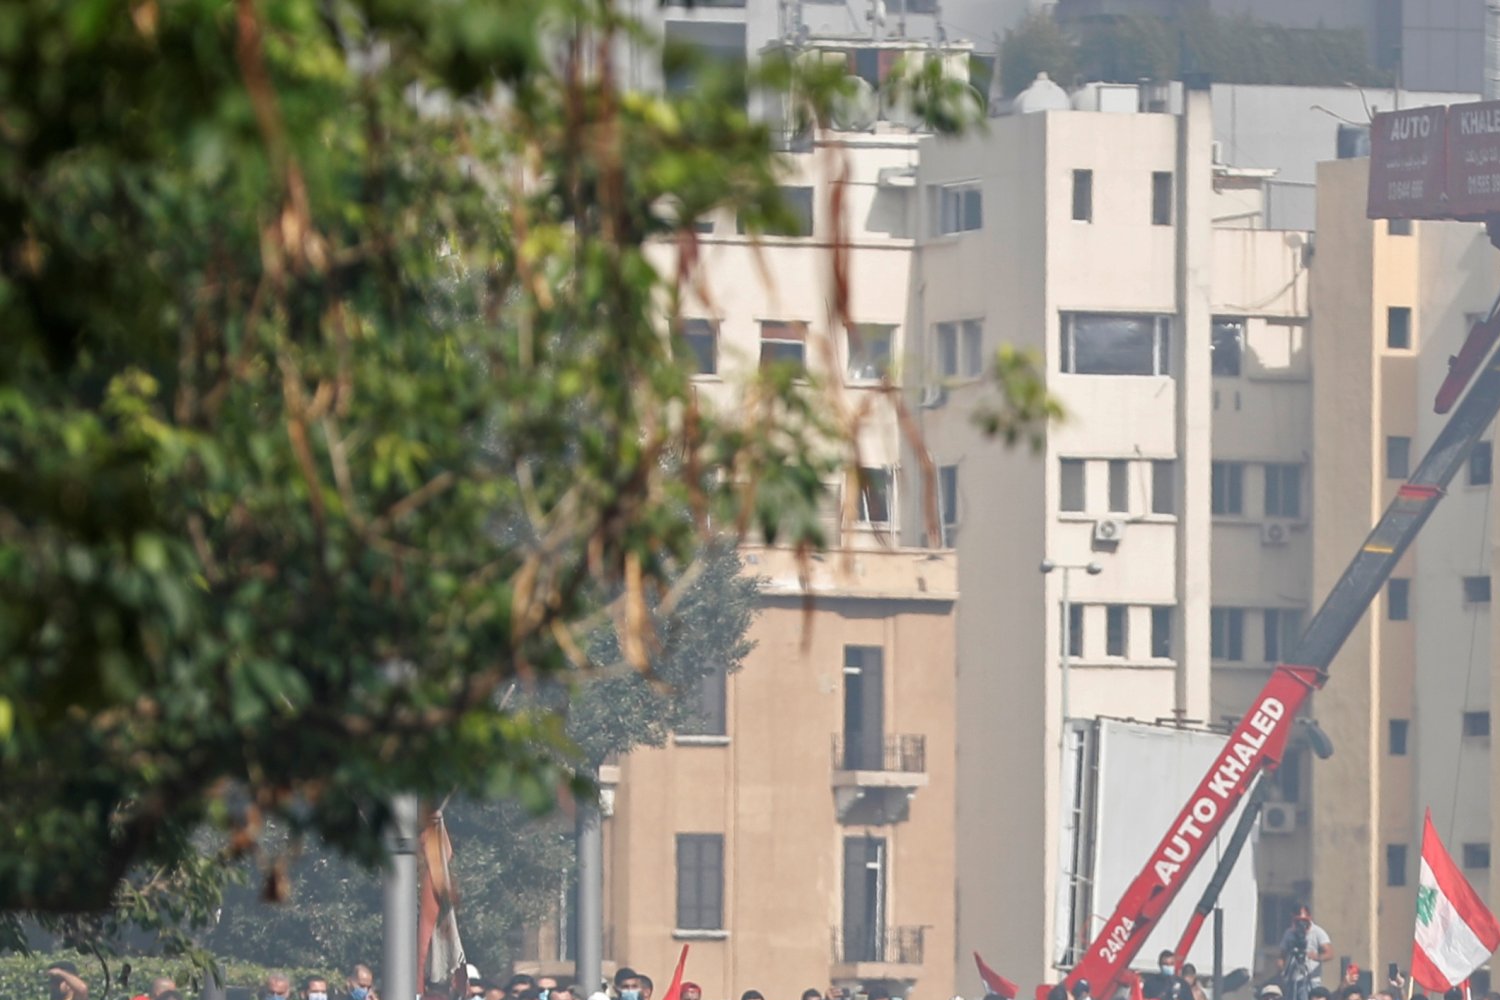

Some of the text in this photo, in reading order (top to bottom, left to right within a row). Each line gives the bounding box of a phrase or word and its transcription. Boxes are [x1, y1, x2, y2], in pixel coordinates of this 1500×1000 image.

[1390, 115, 1430, 141] AUTO
[1153, 697, 1285, 886] AUTO KHALED
[1099, 916, 1136, 964] 24/24
